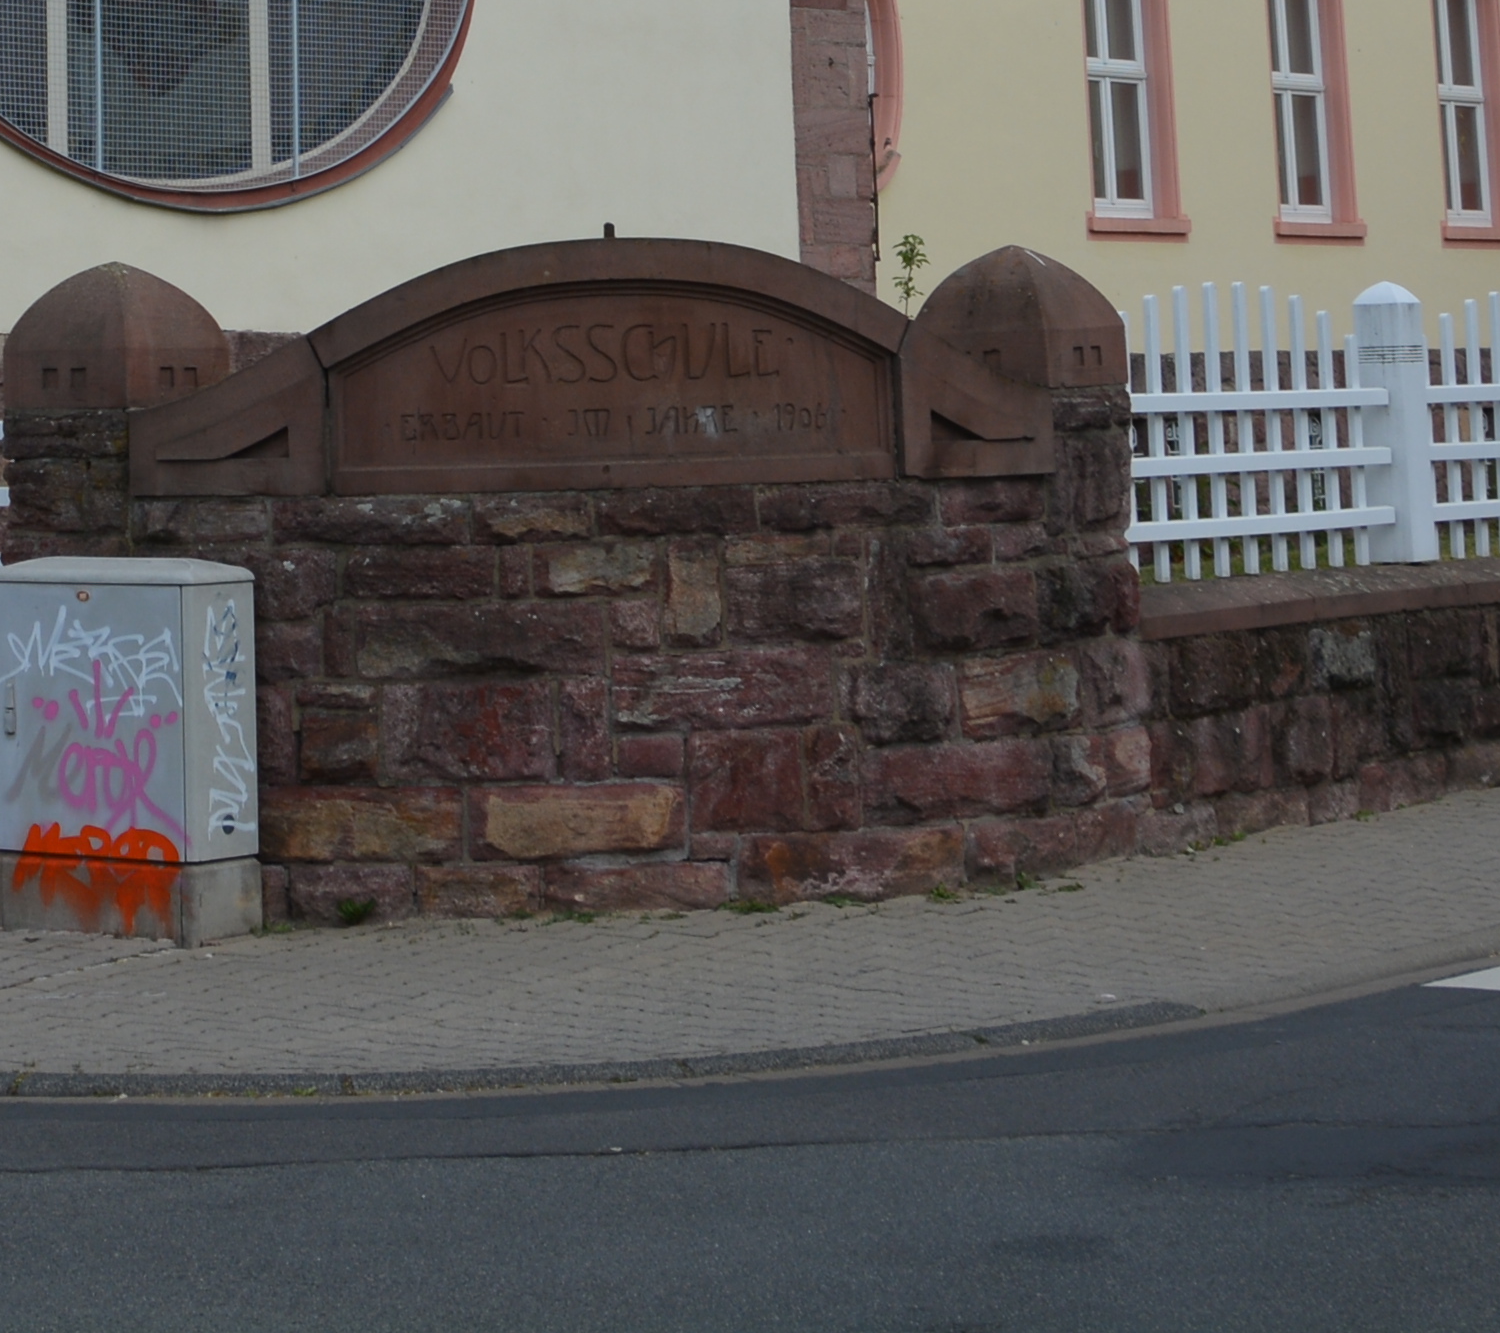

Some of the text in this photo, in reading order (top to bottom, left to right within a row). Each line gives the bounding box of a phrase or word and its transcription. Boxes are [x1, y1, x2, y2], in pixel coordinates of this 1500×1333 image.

[429, 321, 780, 386] VOLKSSCHULE
[400, 409, 526, 442] ERBAUT
[644, 404, 740, 436] JAHRE
[773, 401, 829, 431] 1906
